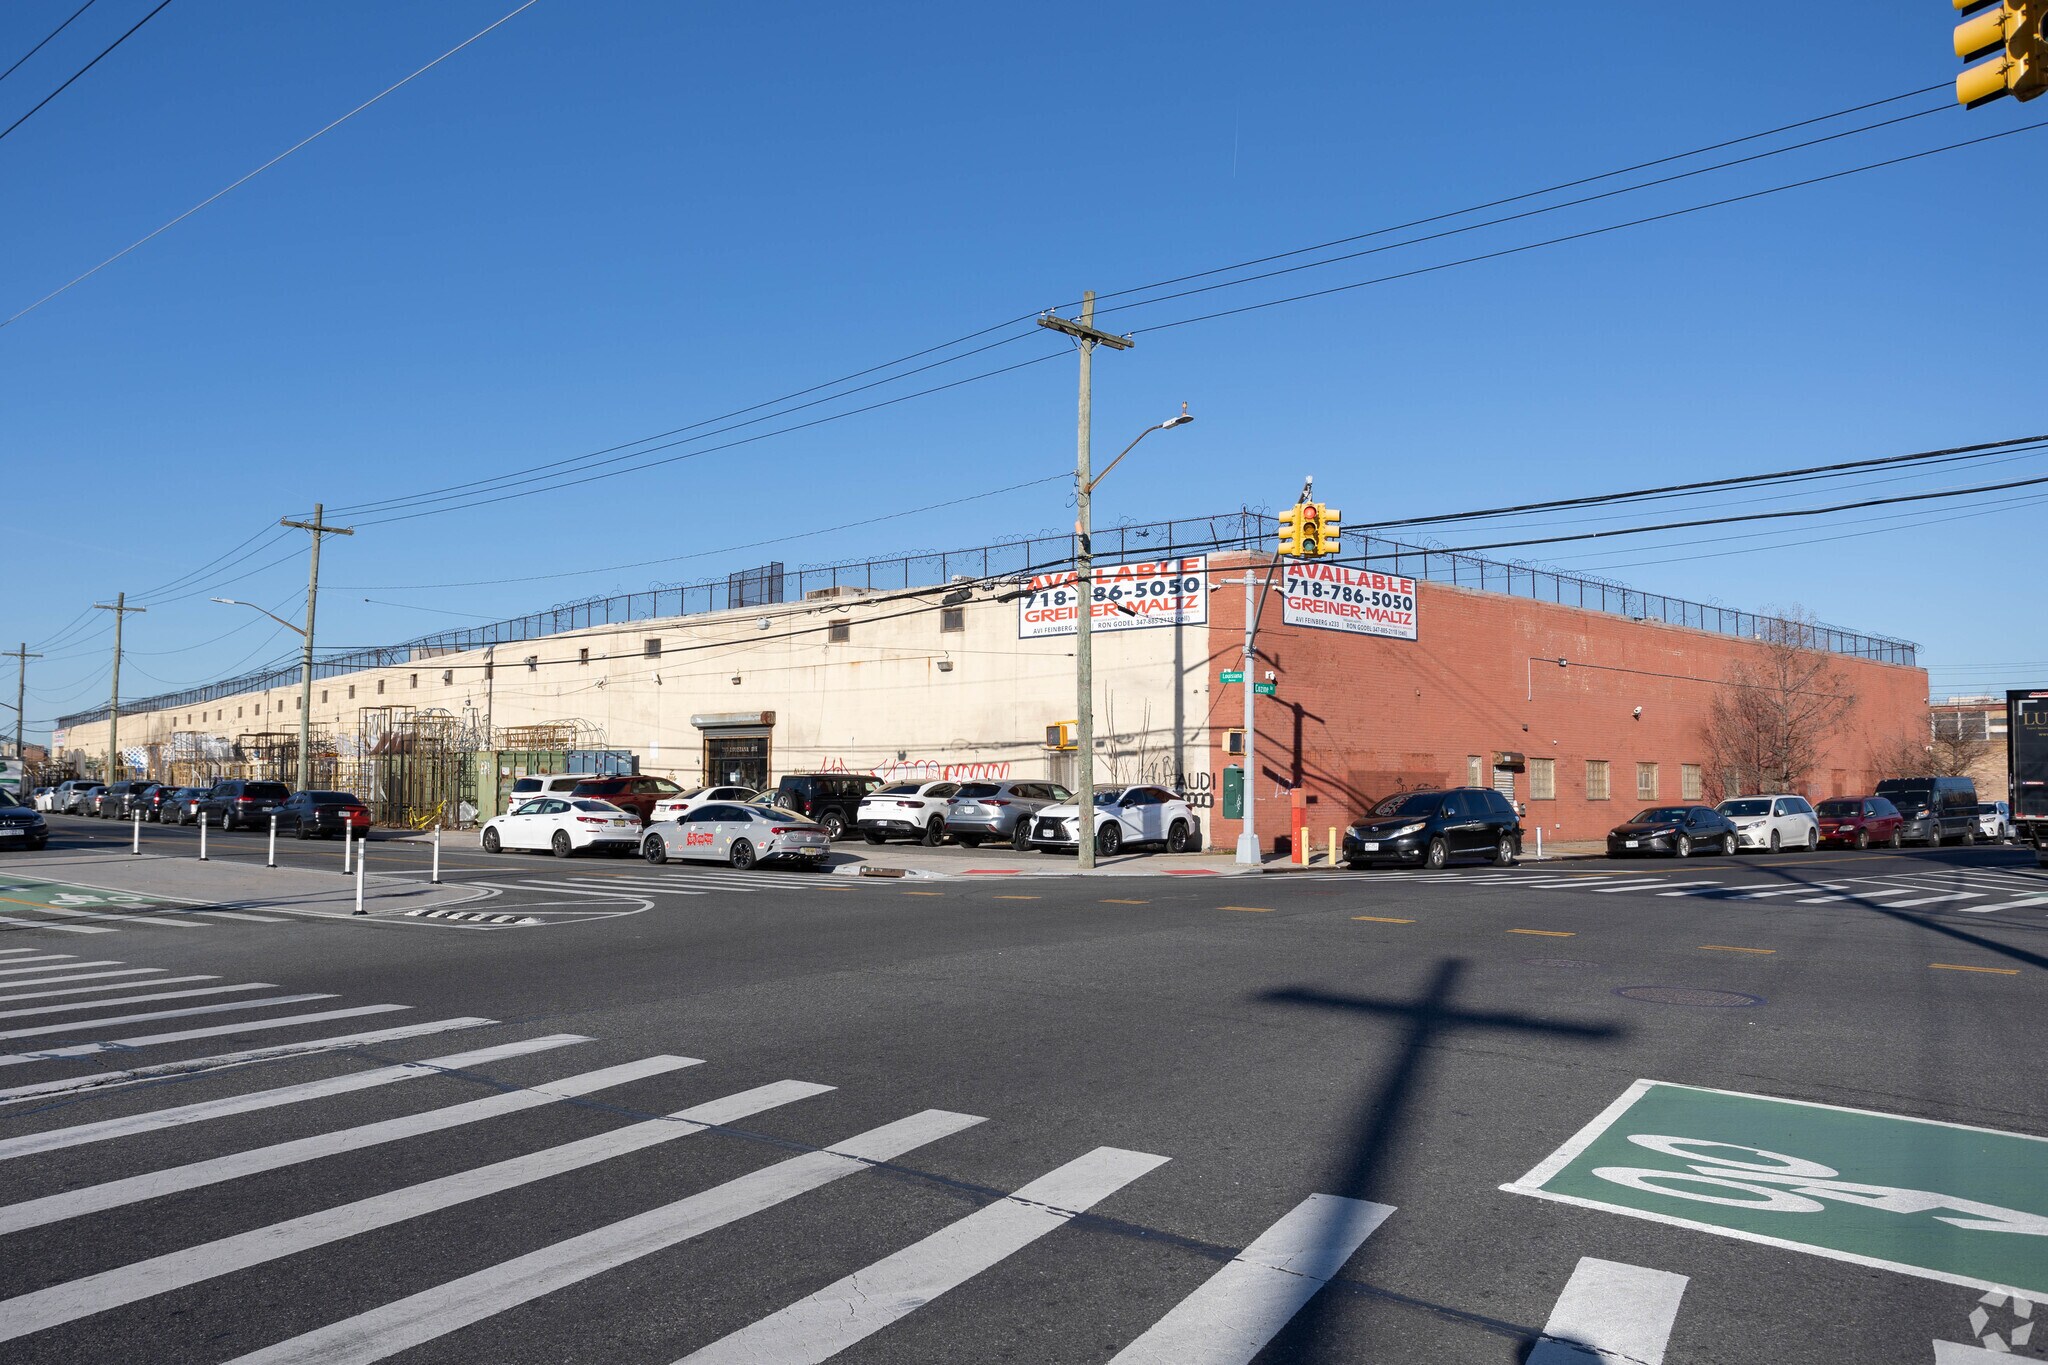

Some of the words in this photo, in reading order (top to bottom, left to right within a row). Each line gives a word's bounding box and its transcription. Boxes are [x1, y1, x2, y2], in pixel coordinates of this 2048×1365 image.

[1026, 558, 1199, 591] AVALABLE
[1288, 560, 1412, 595] AVAILABLE
[1025, 577, 1200, 609] 718-86-5050
[1287, 577, 1413, 611] 718-786-5050
[1098, 621, 1112, 629] RON
[1114, 620, 1134, 628] GODEL
[1288, 596, 1413, 625] GREINER-MALTZ
[1044, 625, 1073, 633] FEINBERG
[1176, 771, 1216, 791] AUDI
